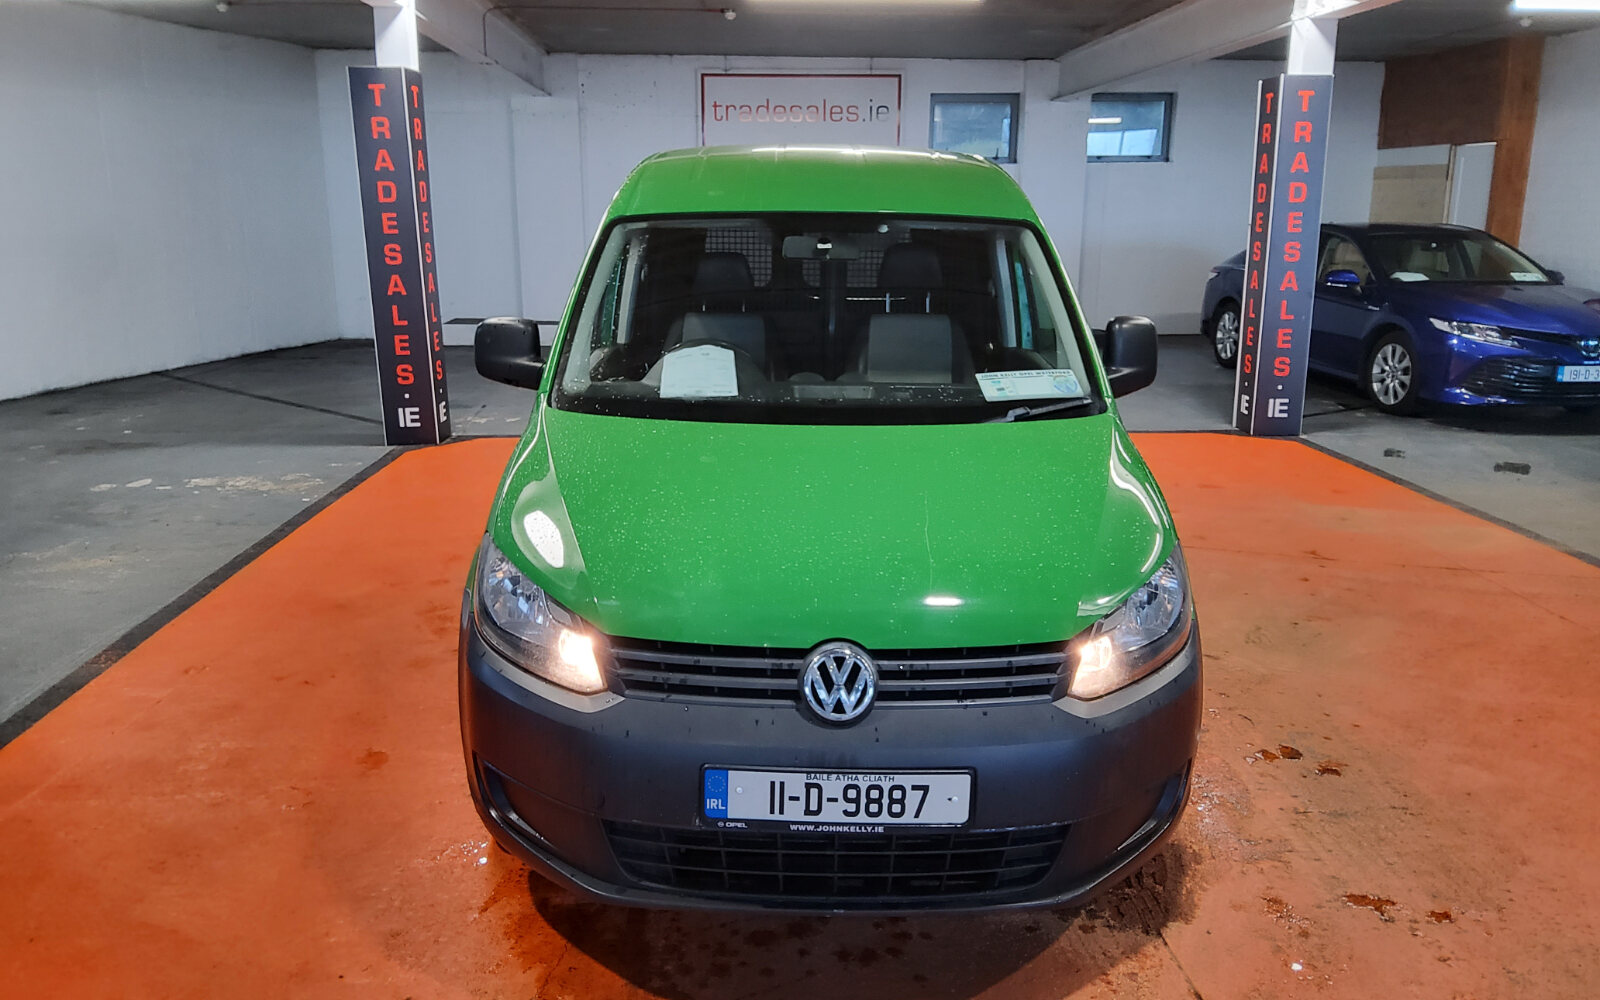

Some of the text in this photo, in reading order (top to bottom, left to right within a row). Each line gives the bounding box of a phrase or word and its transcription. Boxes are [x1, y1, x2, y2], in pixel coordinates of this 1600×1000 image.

[712, 98, 890, 122] tradesales.ie
[367, 83, 422, 428] TRADESALES.IE
[410, 85, 448, 424] TRADESALES.IE
[1267, 89, 1316, 418] TRADESALES.IE
[805, 773, 832, 782] BAILE
[862, 775, 895, 783] CLIATH
[706, 798, 726, 810] IRL
[769, 780, 930, 819] 11-D-9887
[790, 824, 885, 833] WWW.JOHNKELLY.IE
